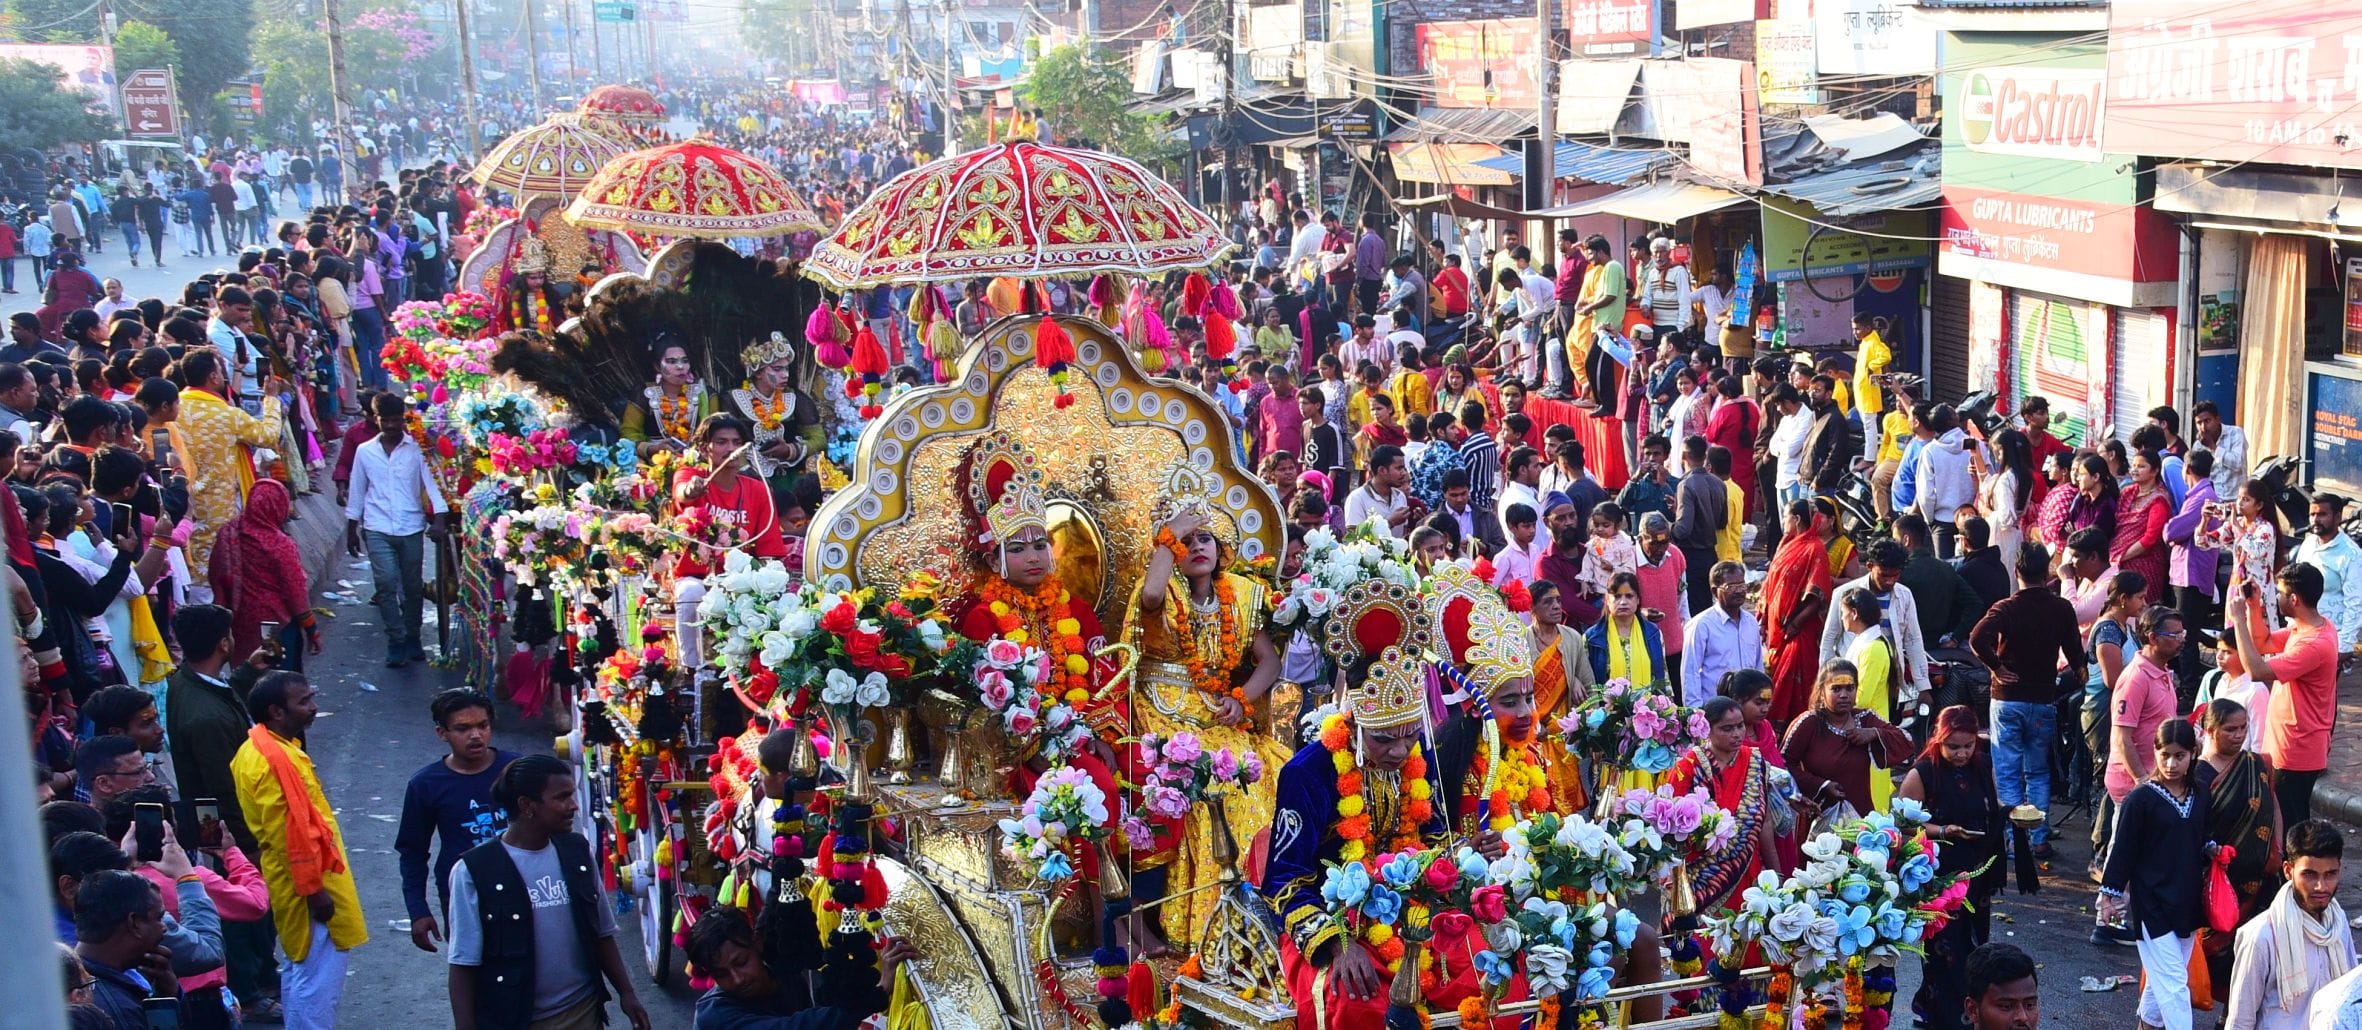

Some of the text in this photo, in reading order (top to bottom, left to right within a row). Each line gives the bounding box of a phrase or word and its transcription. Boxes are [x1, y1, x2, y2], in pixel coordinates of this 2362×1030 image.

[1995, 77, 2101, 148] Castrol
[2269, 120, 2300, 144] AM
[1973, 197, 2095, 234] GUPTA LUBRICANTS
[1777, 270, 1801, 280] GUPTA
[2118, 699, 2127, 715] 3
